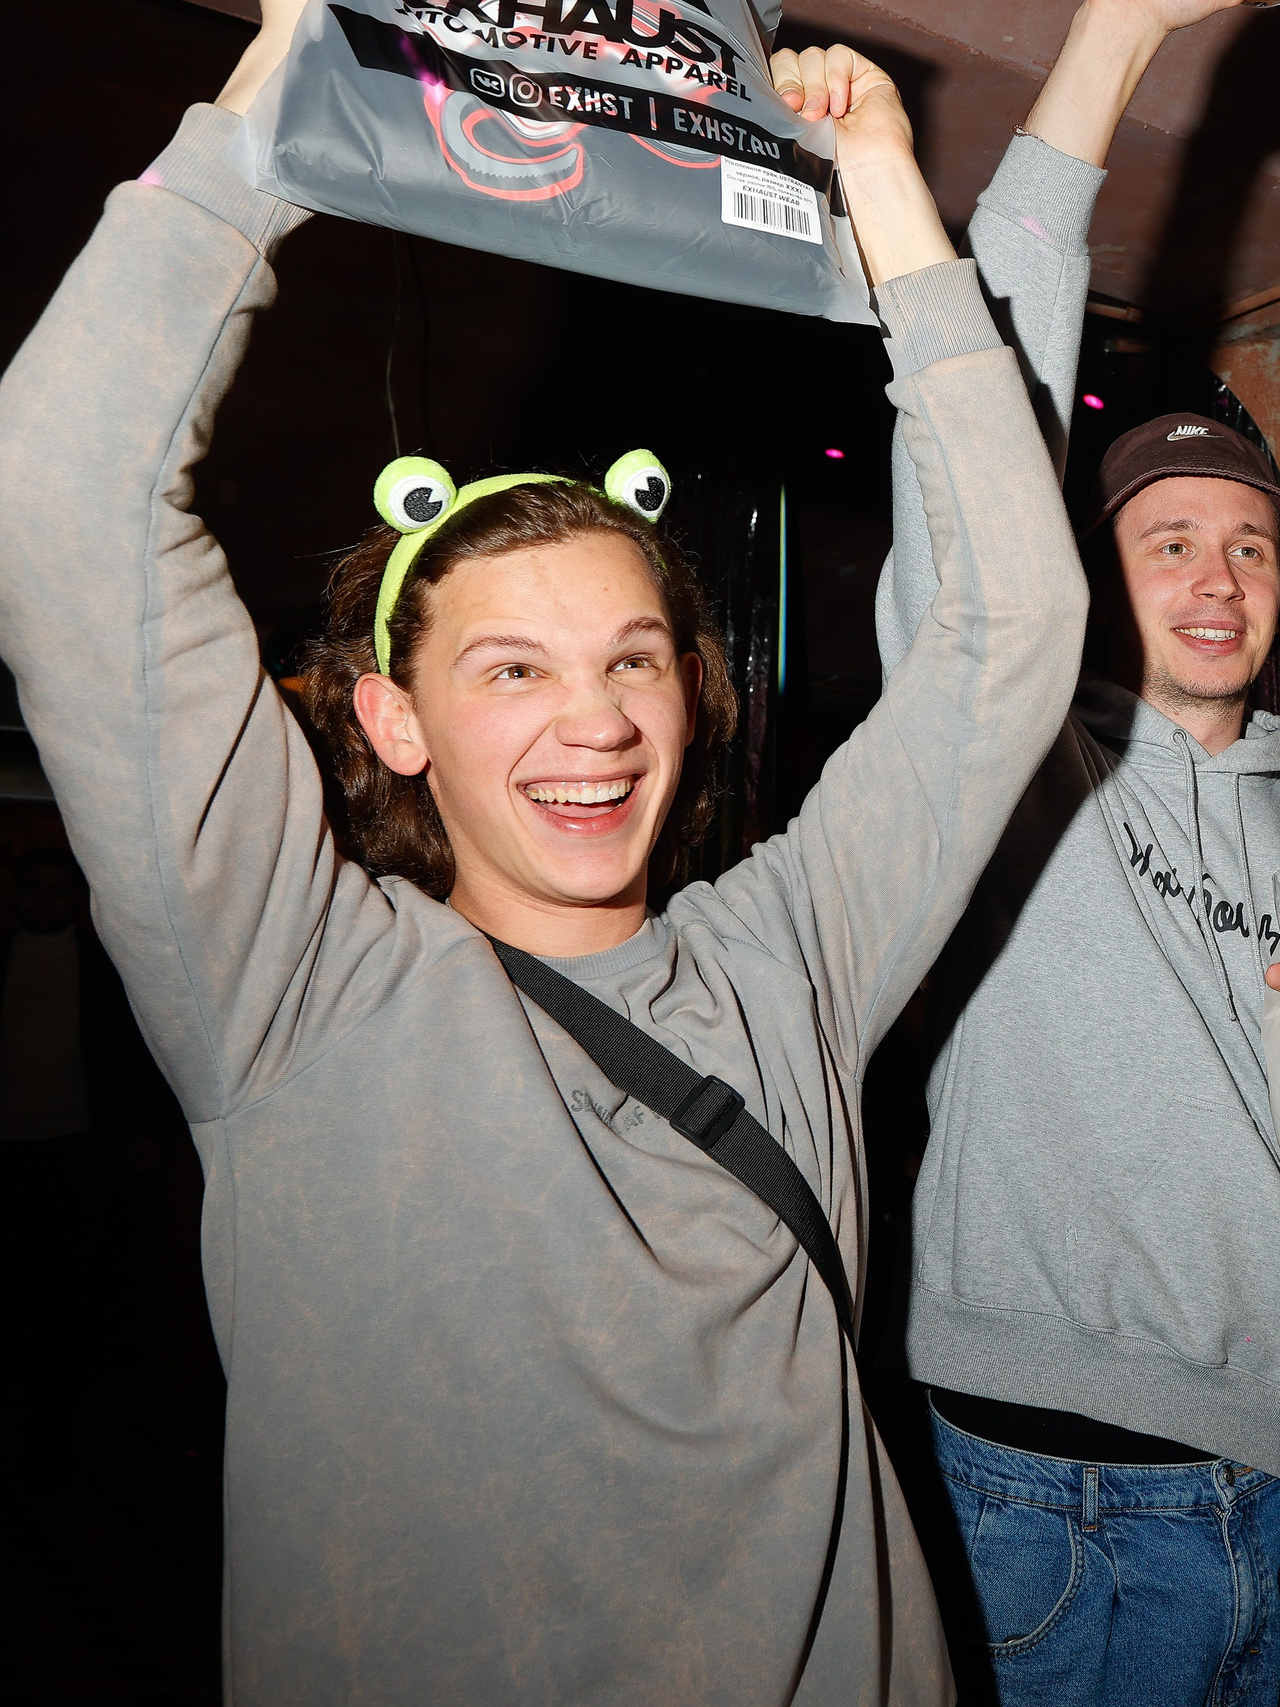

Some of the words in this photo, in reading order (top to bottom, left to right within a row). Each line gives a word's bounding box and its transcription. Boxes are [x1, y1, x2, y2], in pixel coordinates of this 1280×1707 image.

[619, 48, 752, 102] APPAREL
[548, 86, 634, 120] EXHST
[674, 108, 780, 160] EXHST.RU
[742, 185, 778, 198] EXHAUST
[779, 194, 800, 206] WEAR
[786, 184, 803, 195] XXXL
[1174, 425, 1210, 436] NIKE
